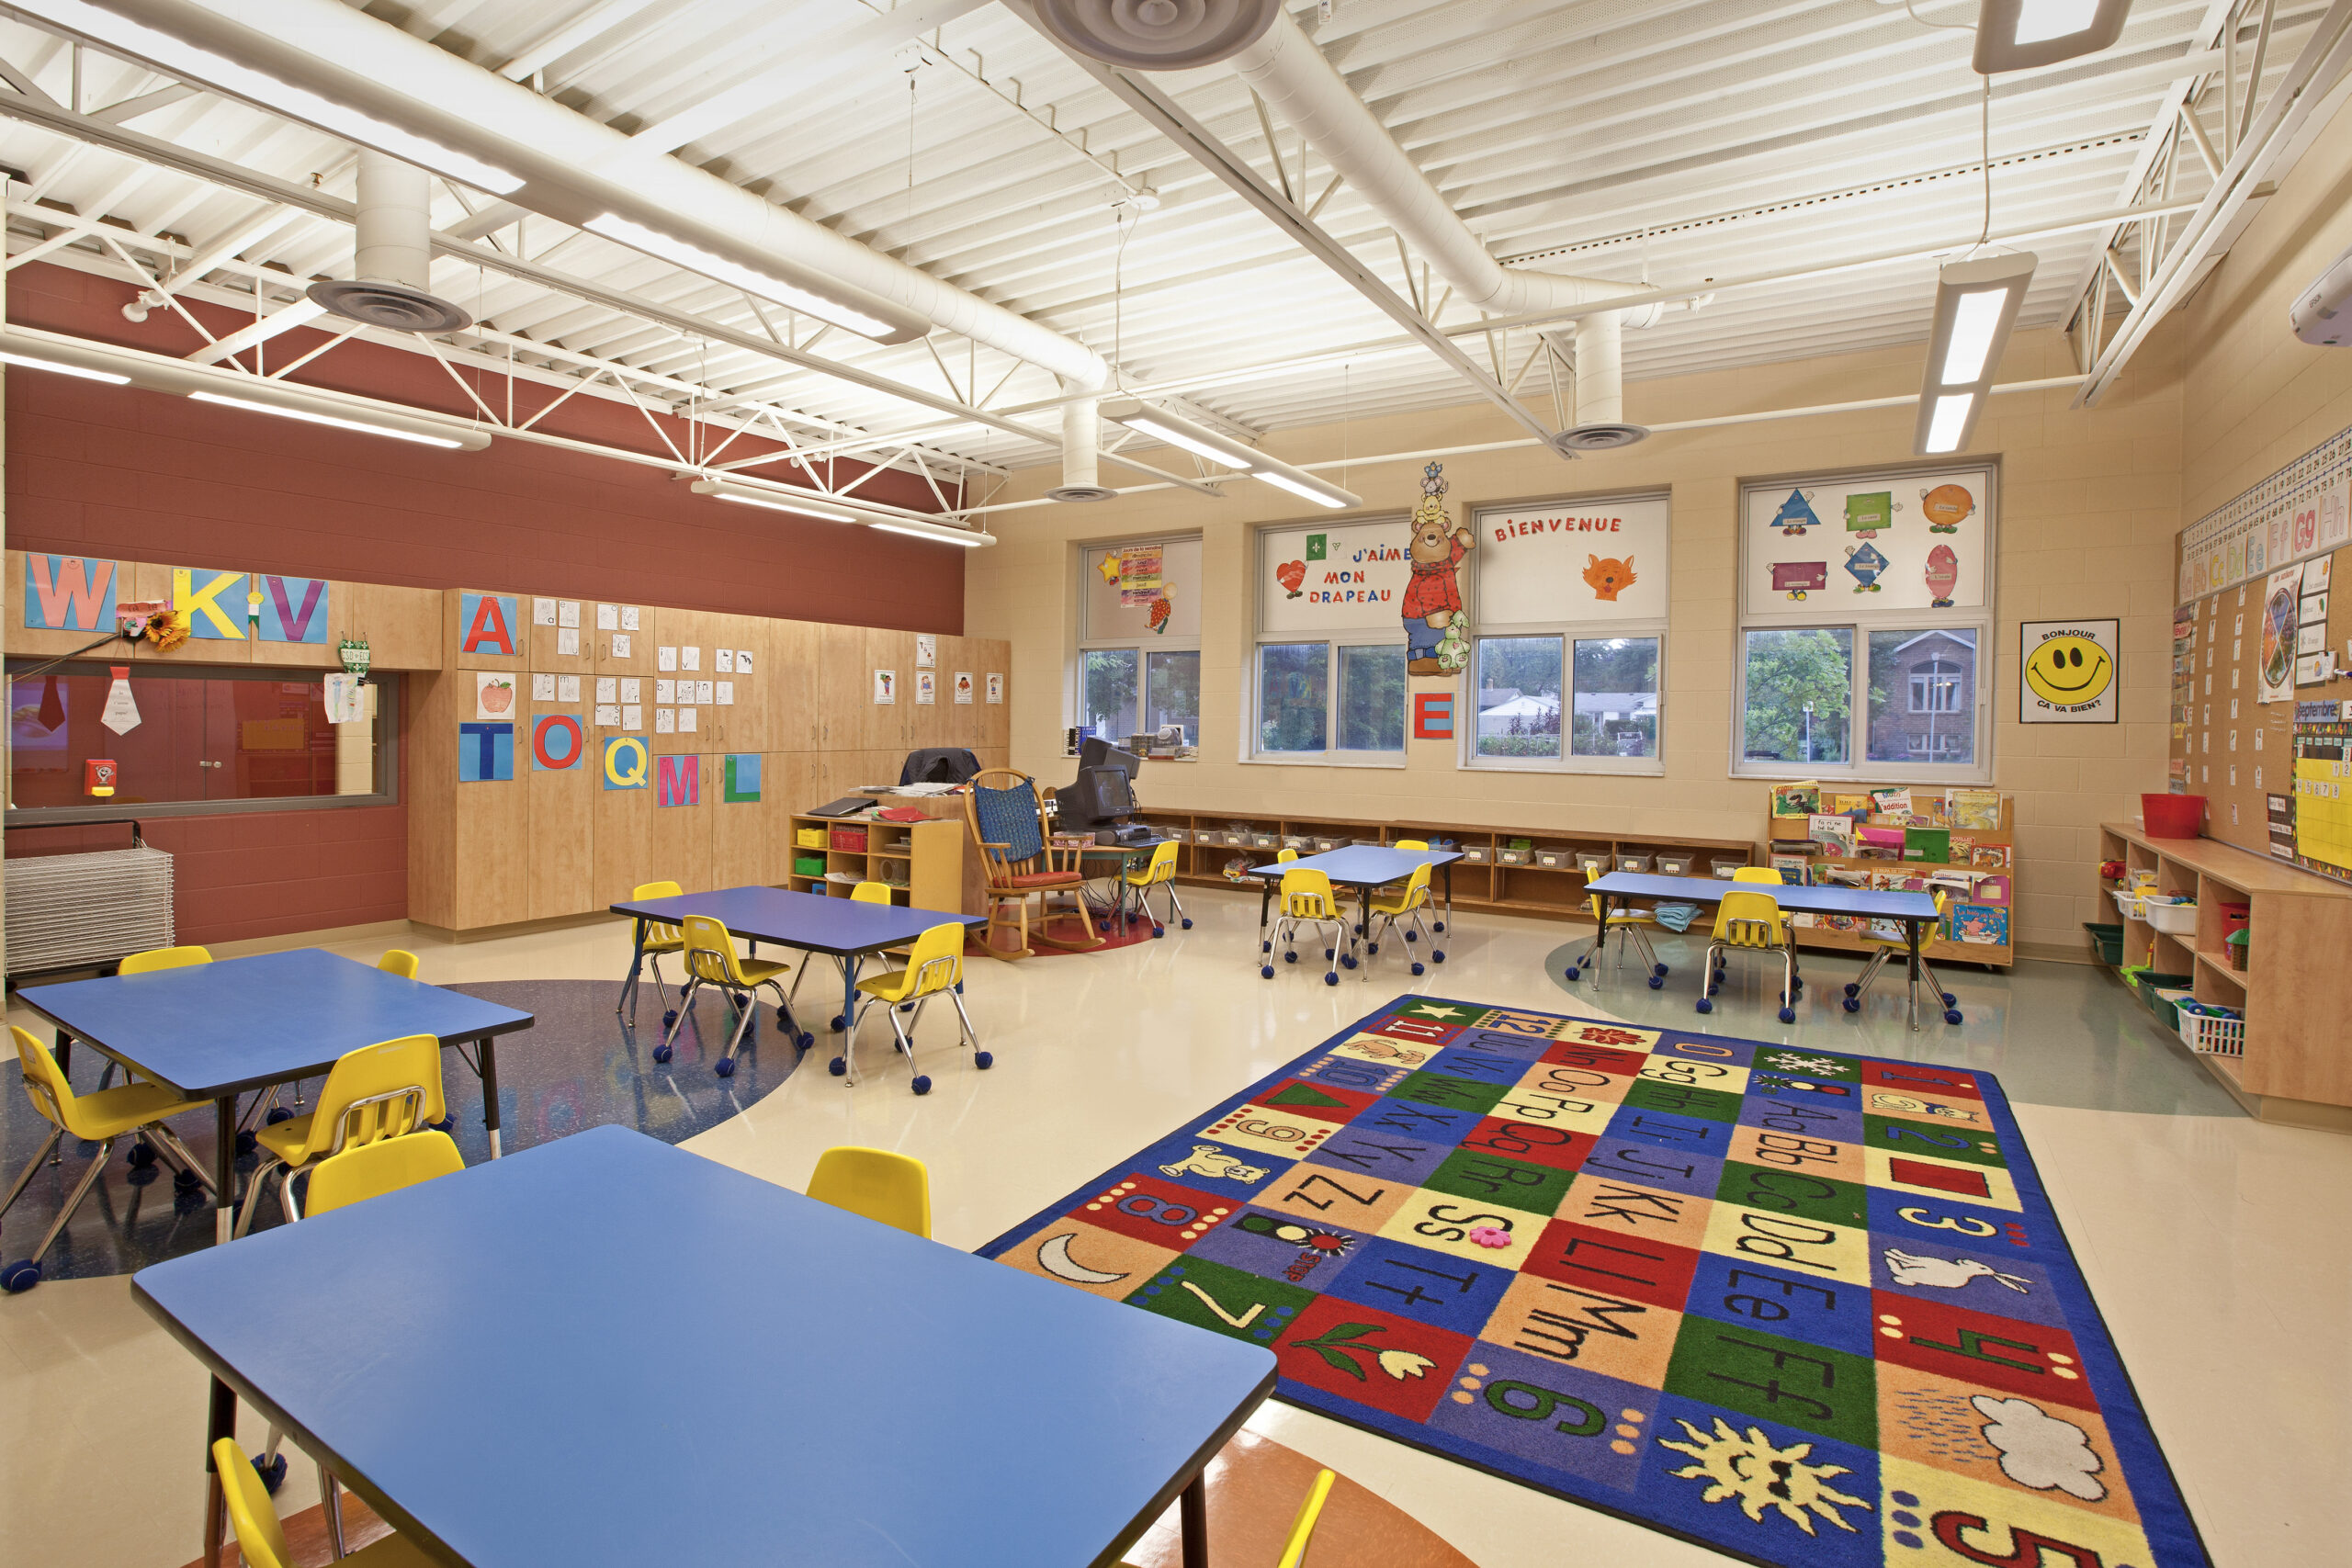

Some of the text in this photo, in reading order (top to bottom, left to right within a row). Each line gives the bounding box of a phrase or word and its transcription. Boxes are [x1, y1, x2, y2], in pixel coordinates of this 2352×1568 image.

[2294, 510, 2315, 552] Gg
[28, 553, 116, 630] W
[1309, 590, 1391, 604] DRAPEAU
[1324, 570, 1364, 584] MON
[173, 569, 246, 640] K
[265, 576, 325, 642] V
[462, 596, 515, 654] A
[2041, 629, 2096, 640] BONJOUR
[1415, 694, 1452, 739] E
[2037, 699, 2101, 713] CA VA BIEN?
[460, 723, 514, 780] T
[533, 715, 582, 770] O
[604, 738, 647, 787] Q
[658, 756, 699, 807] M
[724, 755, 762, 803] L
[1385, 1020, 1446, 1039] 11
[1489, 1013, 1551, 1035] 12
[1317, 1061, 1389, 1087] 10
[1881, 1070, 1956, 1087] 1
[1886, 1125, 1973, 1149] 2
[1116, 1194, 1199, 1226] 8
[1895, 1206, 1998, 1237] 3
[1282, 1252, 1322, 1283] STOP
[1180, 1279, 1269, 1329] 7
[1909, 1327, 2045, 1375] 4
[1483, 1380, 1607, 1438] 6
